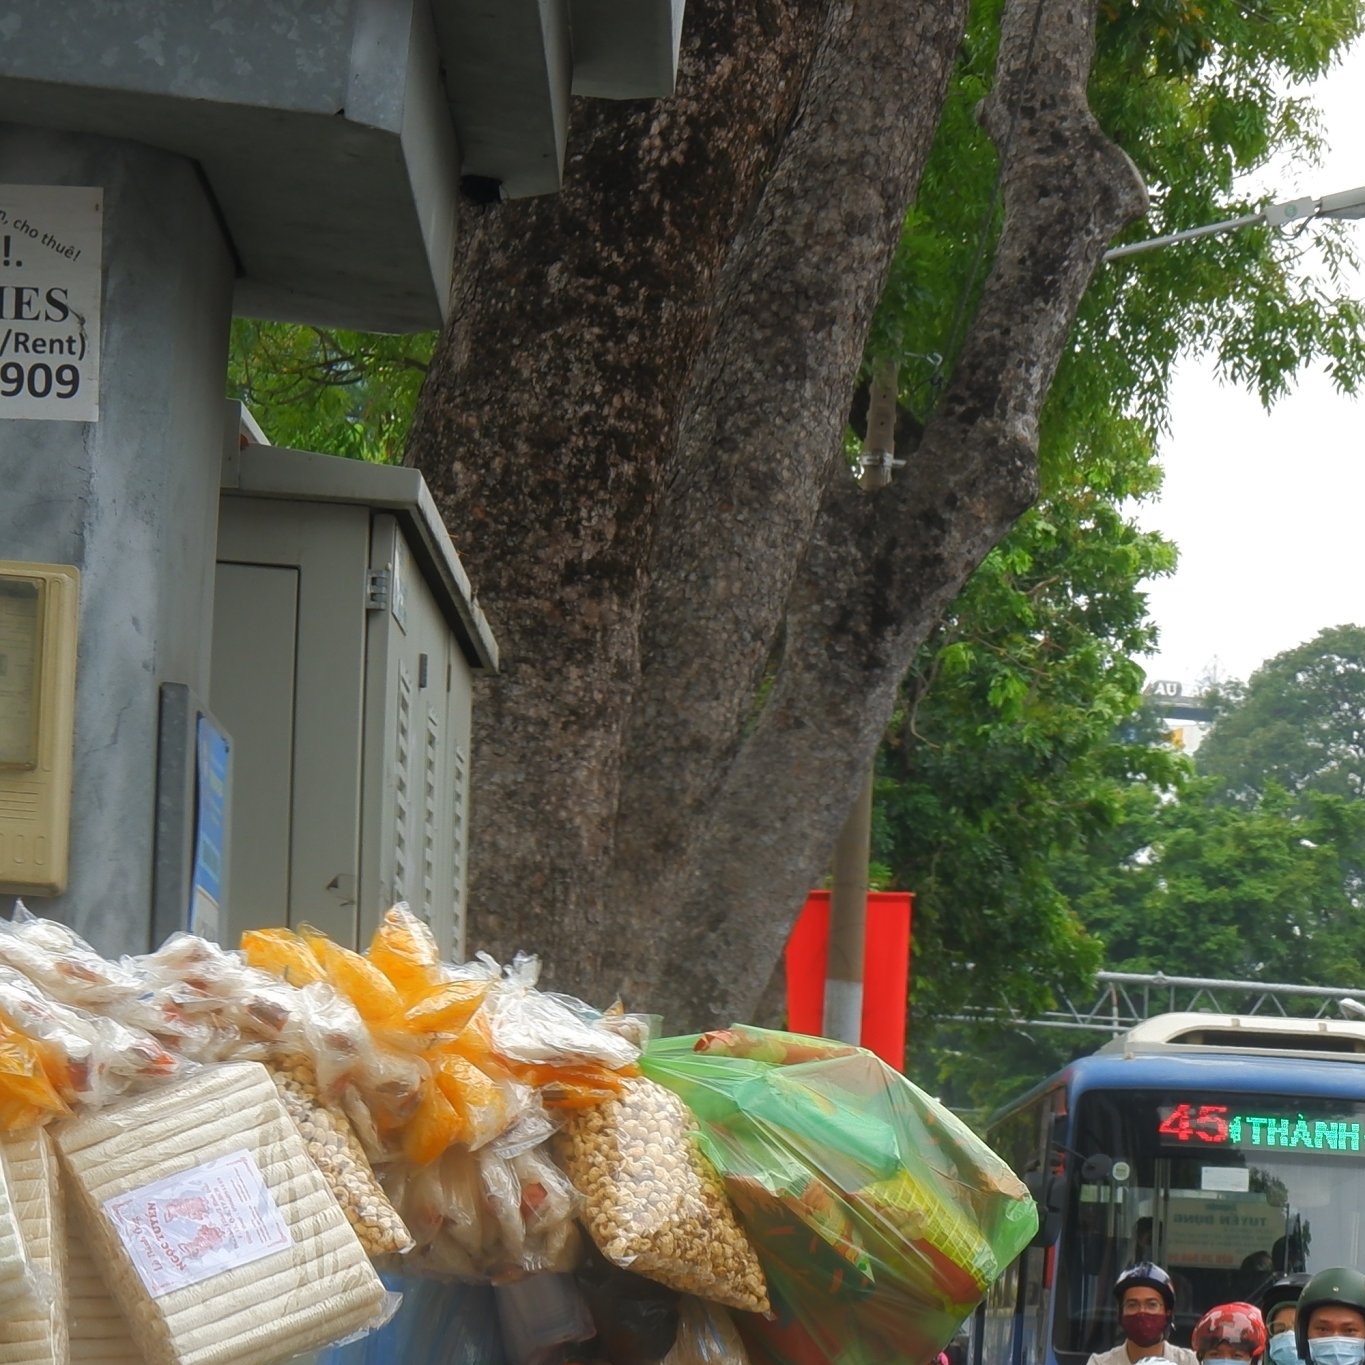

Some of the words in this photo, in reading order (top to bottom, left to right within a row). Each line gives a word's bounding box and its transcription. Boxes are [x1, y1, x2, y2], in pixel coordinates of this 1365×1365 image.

[13, 216, 39, 239] cho
[41, 233, 82, 263] thuê!
[0, 361, 80, 399] 909
[1158, 1103, 1228, 1143] 45
[1246, 1113, 1360, 1151] THÀNH
